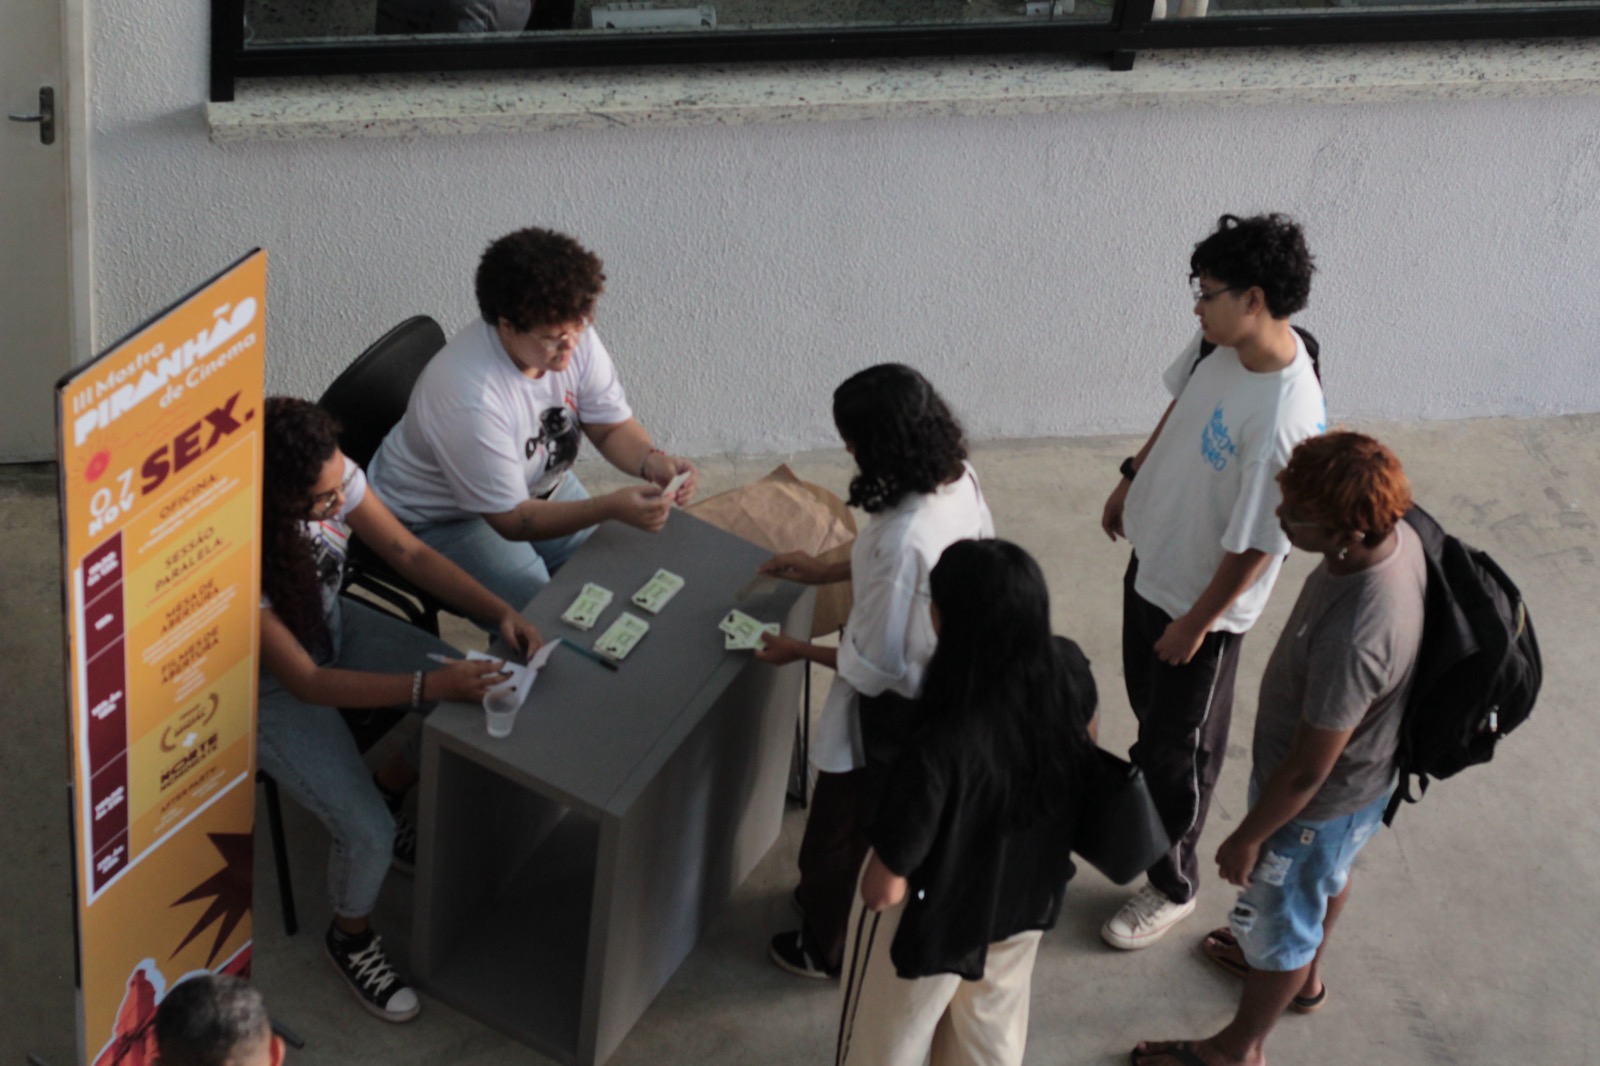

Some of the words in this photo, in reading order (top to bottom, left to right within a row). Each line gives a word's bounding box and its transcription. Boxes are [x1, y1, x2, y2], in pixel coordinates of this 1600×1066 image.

[74, 297, 257, 447] PIRANHÃO
[96, 342, 165, 398] Mostra
[160, 383, 183, 409] de
[186, 332, 256, 390] Cinema
[141, 390, 255, 496] SEX.
[88, 491, 136, 538] NOV
[89, 467, 134, 518] 07
